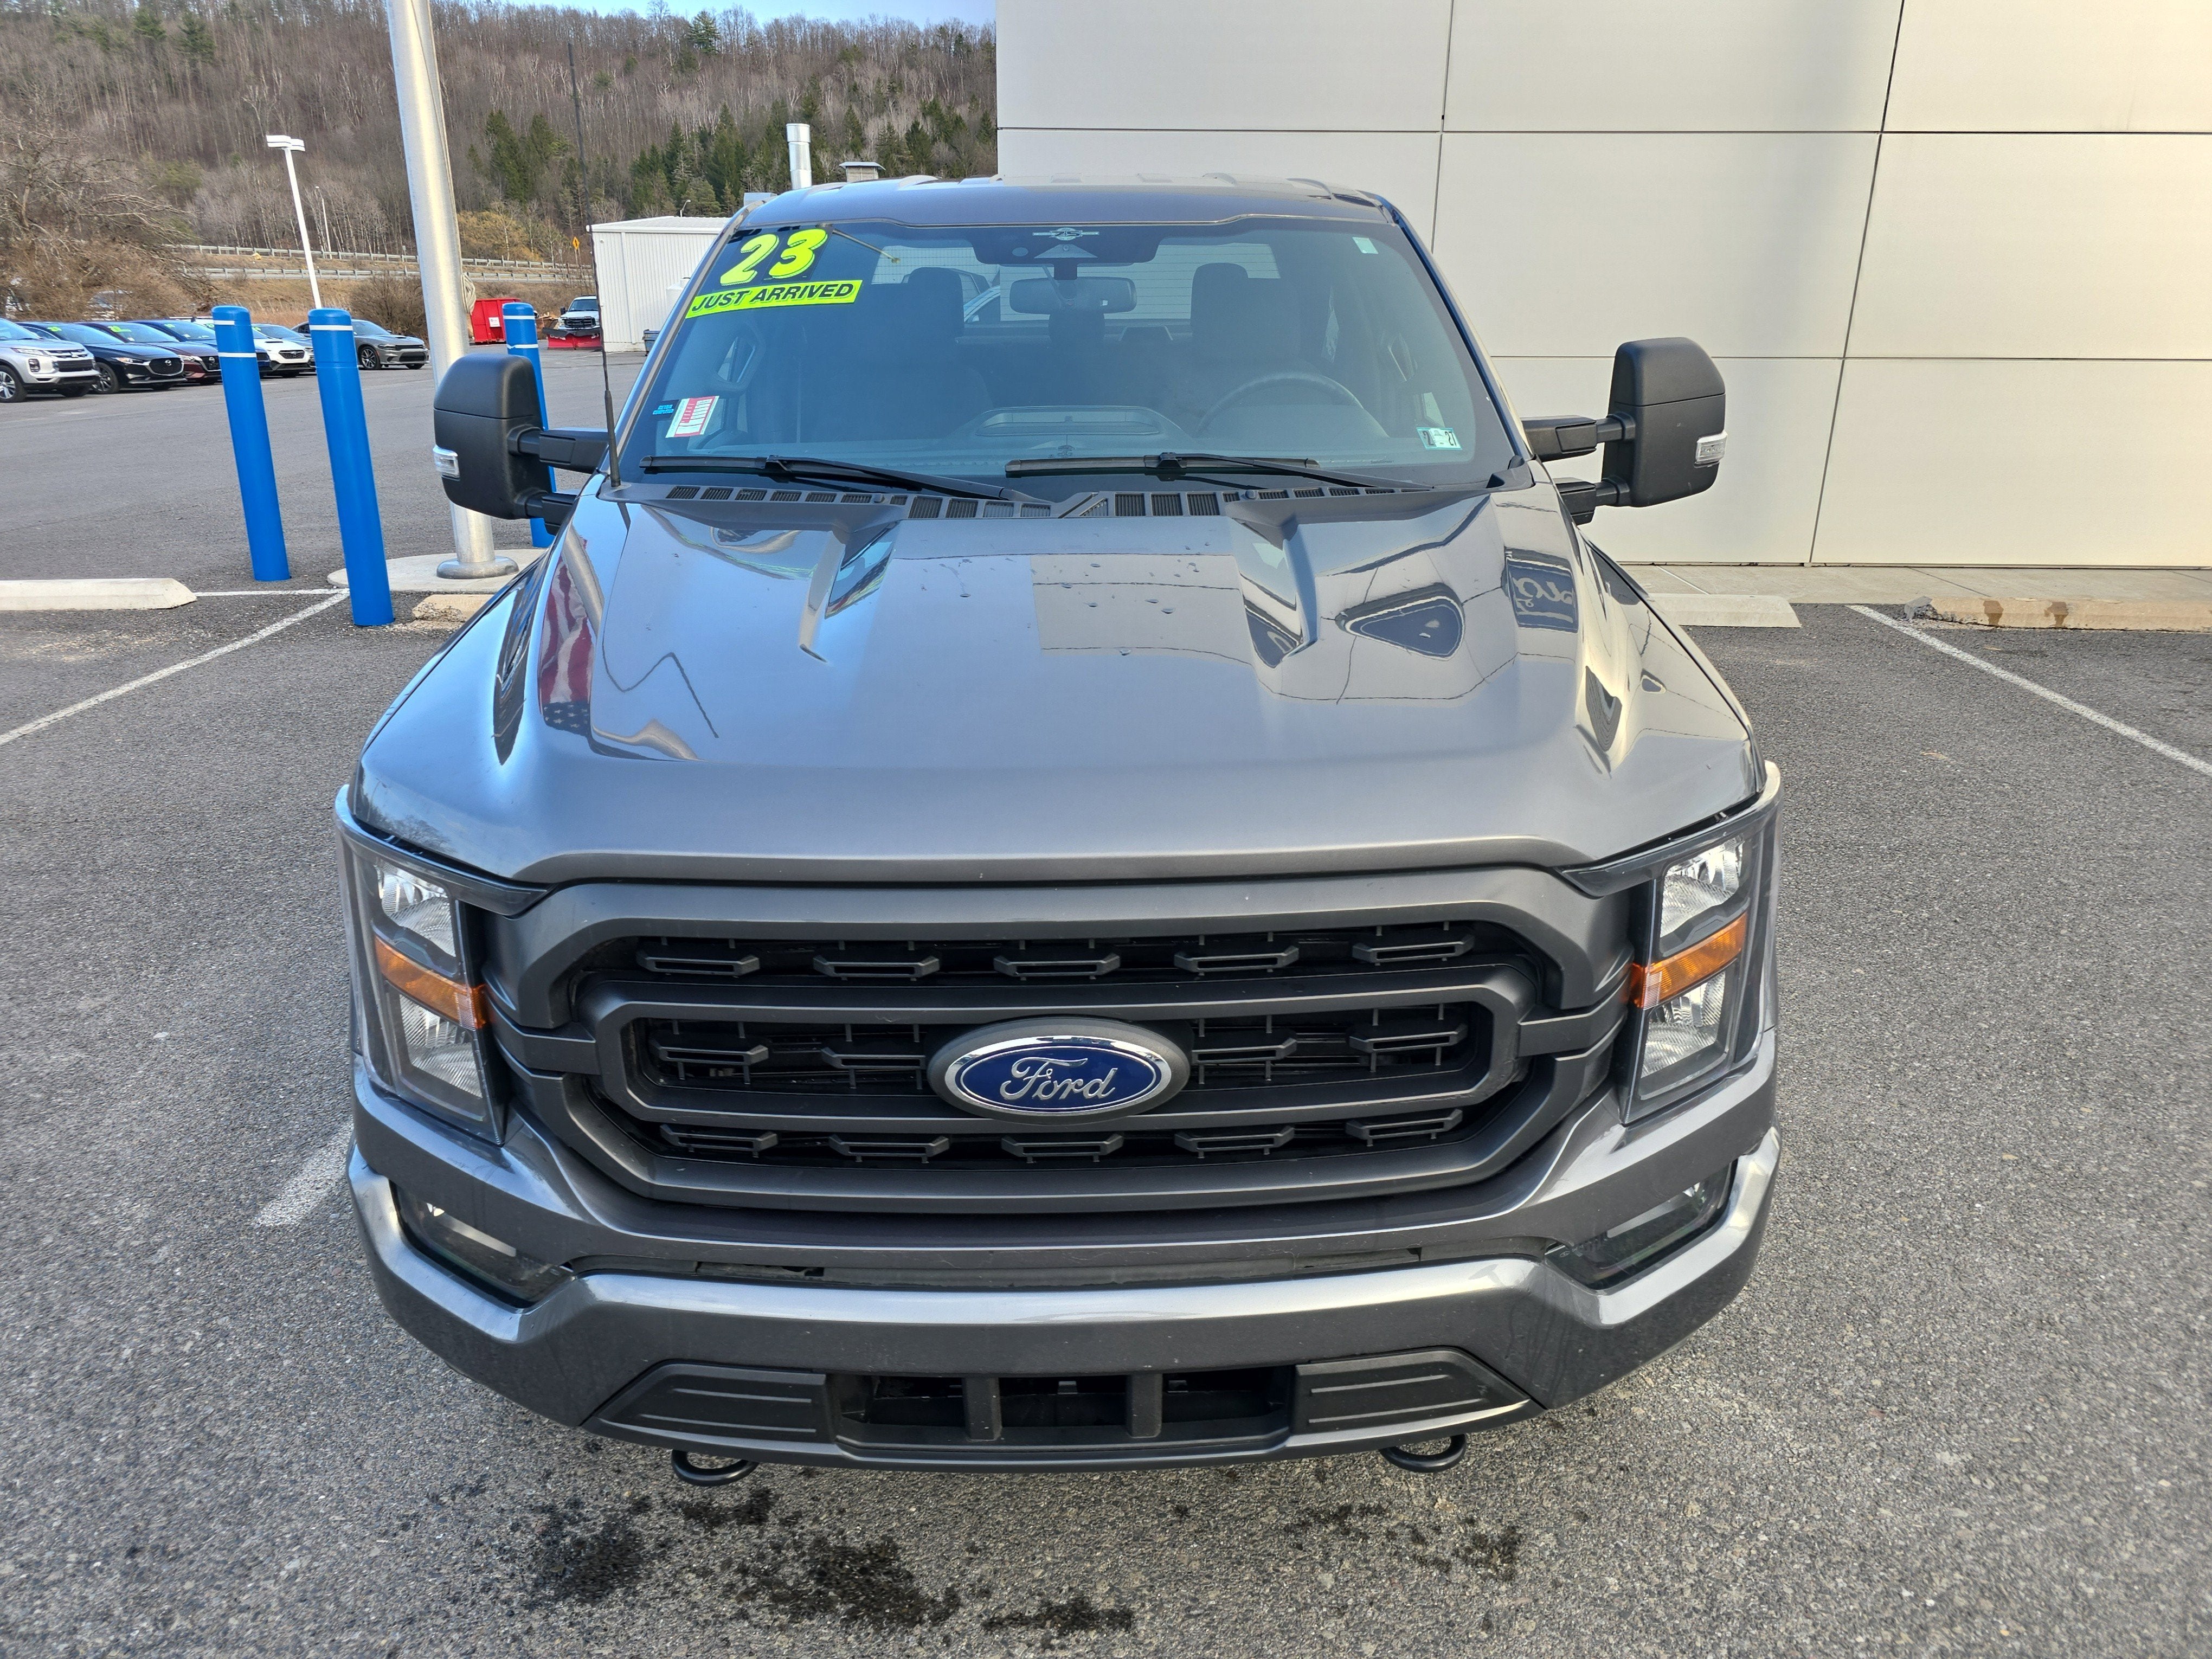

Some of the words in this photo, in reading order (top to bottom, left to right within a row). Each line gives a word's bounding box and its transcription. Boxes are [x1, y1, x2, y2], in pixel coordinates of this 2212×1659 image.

[720, 229, 828, 286] 23
[692, 290, 750, 313] JUST
[749, 284, 854, 303] ARRIVED
[1422, 430, 1435, 447] 2
[999, 1057, 1118, 1100] Ford
